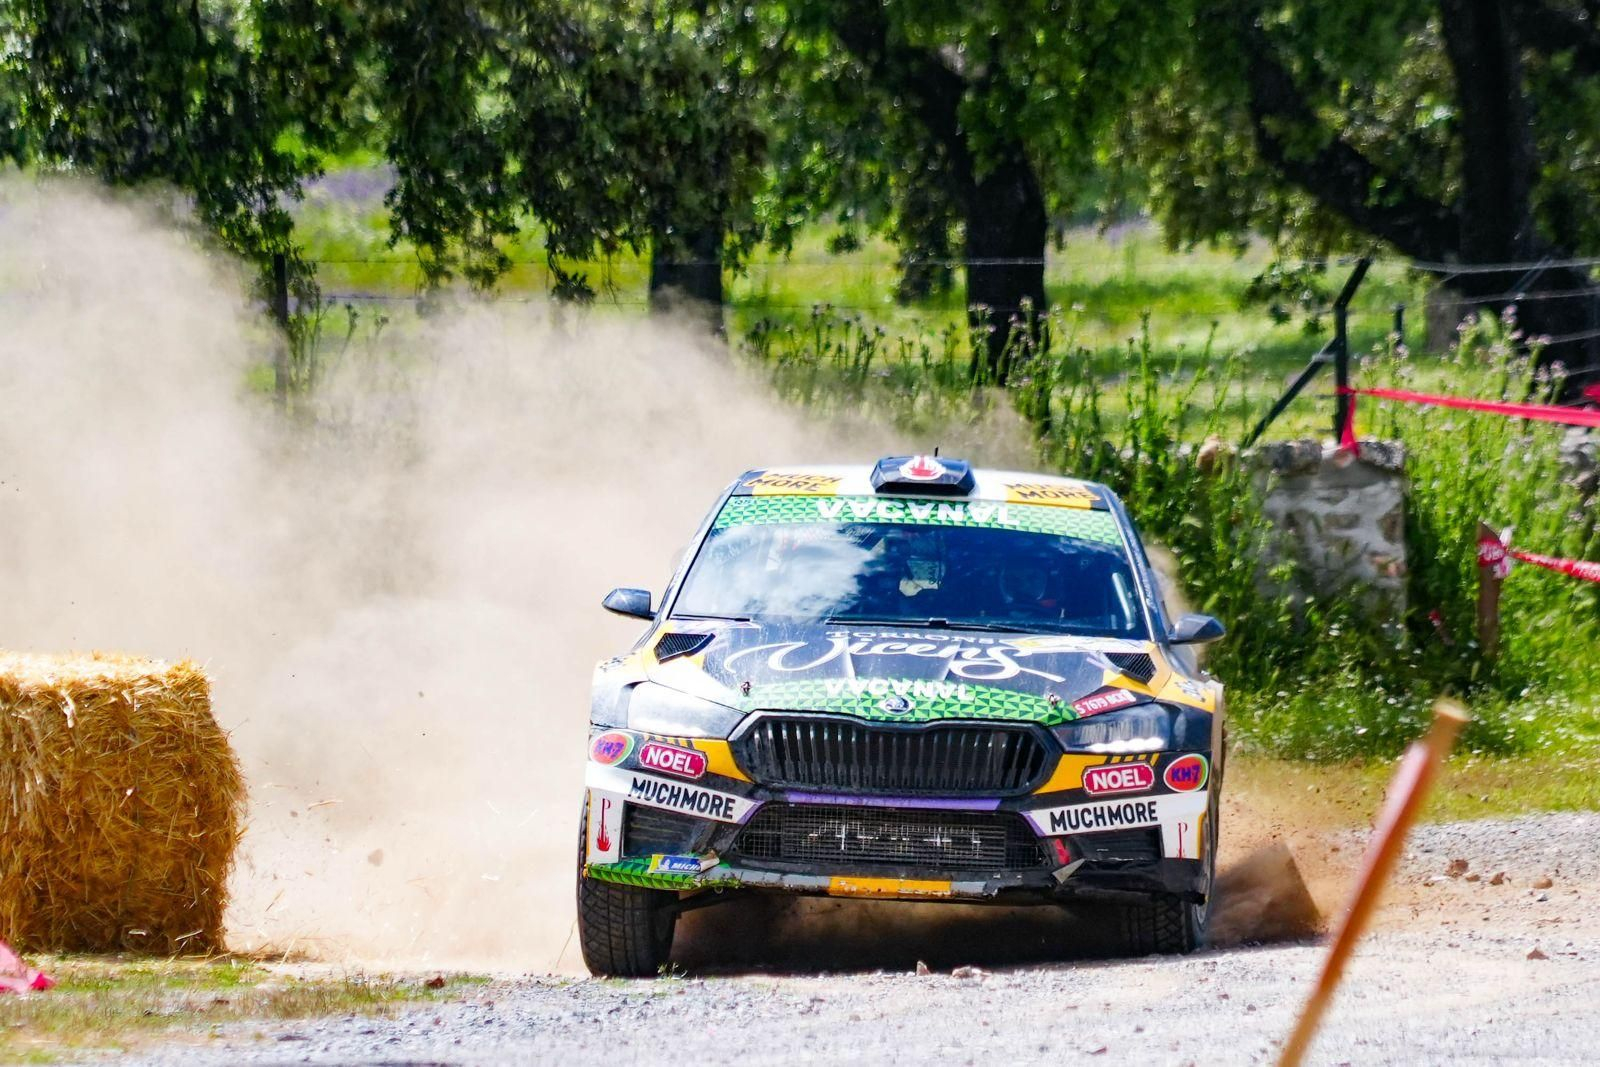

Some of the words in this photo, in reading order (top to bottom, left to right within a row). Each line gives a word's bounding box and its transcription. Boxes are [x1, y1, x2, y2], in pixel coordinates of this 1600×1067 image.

[744, 477, 821, 492] MORE
[825, 631, 995, 645] TORRONS
[645, 747, 695, 775] NOEL
[1091, 768, 1147, 791] NOEL
[627, 777, 736, 820] MUCHMORE
[1050, 800, 1159, 833] MUCHMORE
